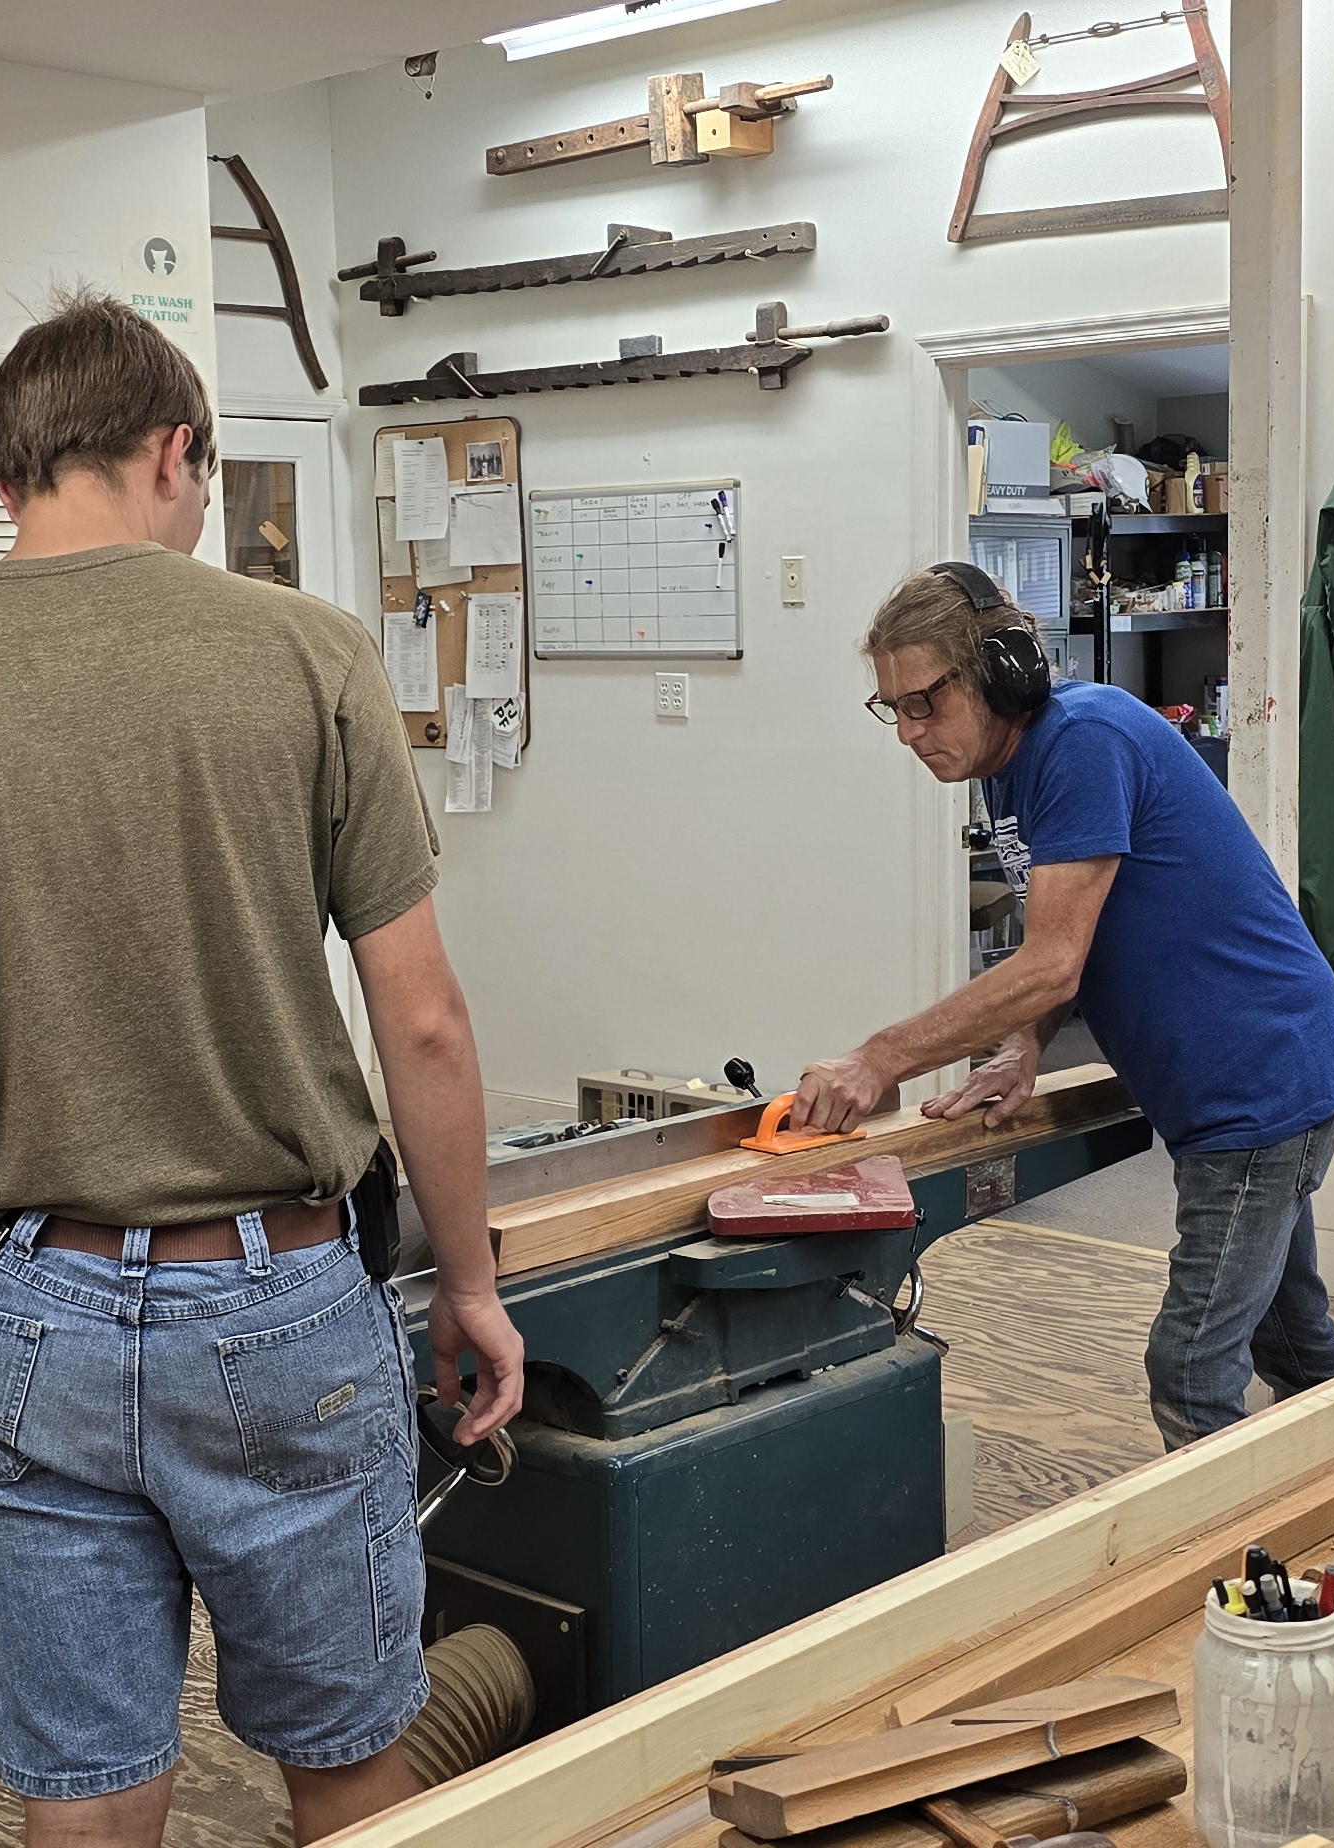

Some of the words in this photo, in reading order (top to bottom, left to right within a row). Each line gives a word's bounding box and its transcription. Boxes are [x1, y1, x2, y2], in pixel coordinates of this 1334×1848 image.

[132, 294, 155, 306] EYE
[158, 296, 193, 309] WASH
[138, 309, 188, 322] STATION
[987, 485, 1006, 496] EAVY
[1007, 486, 1027, 496] DUTY
